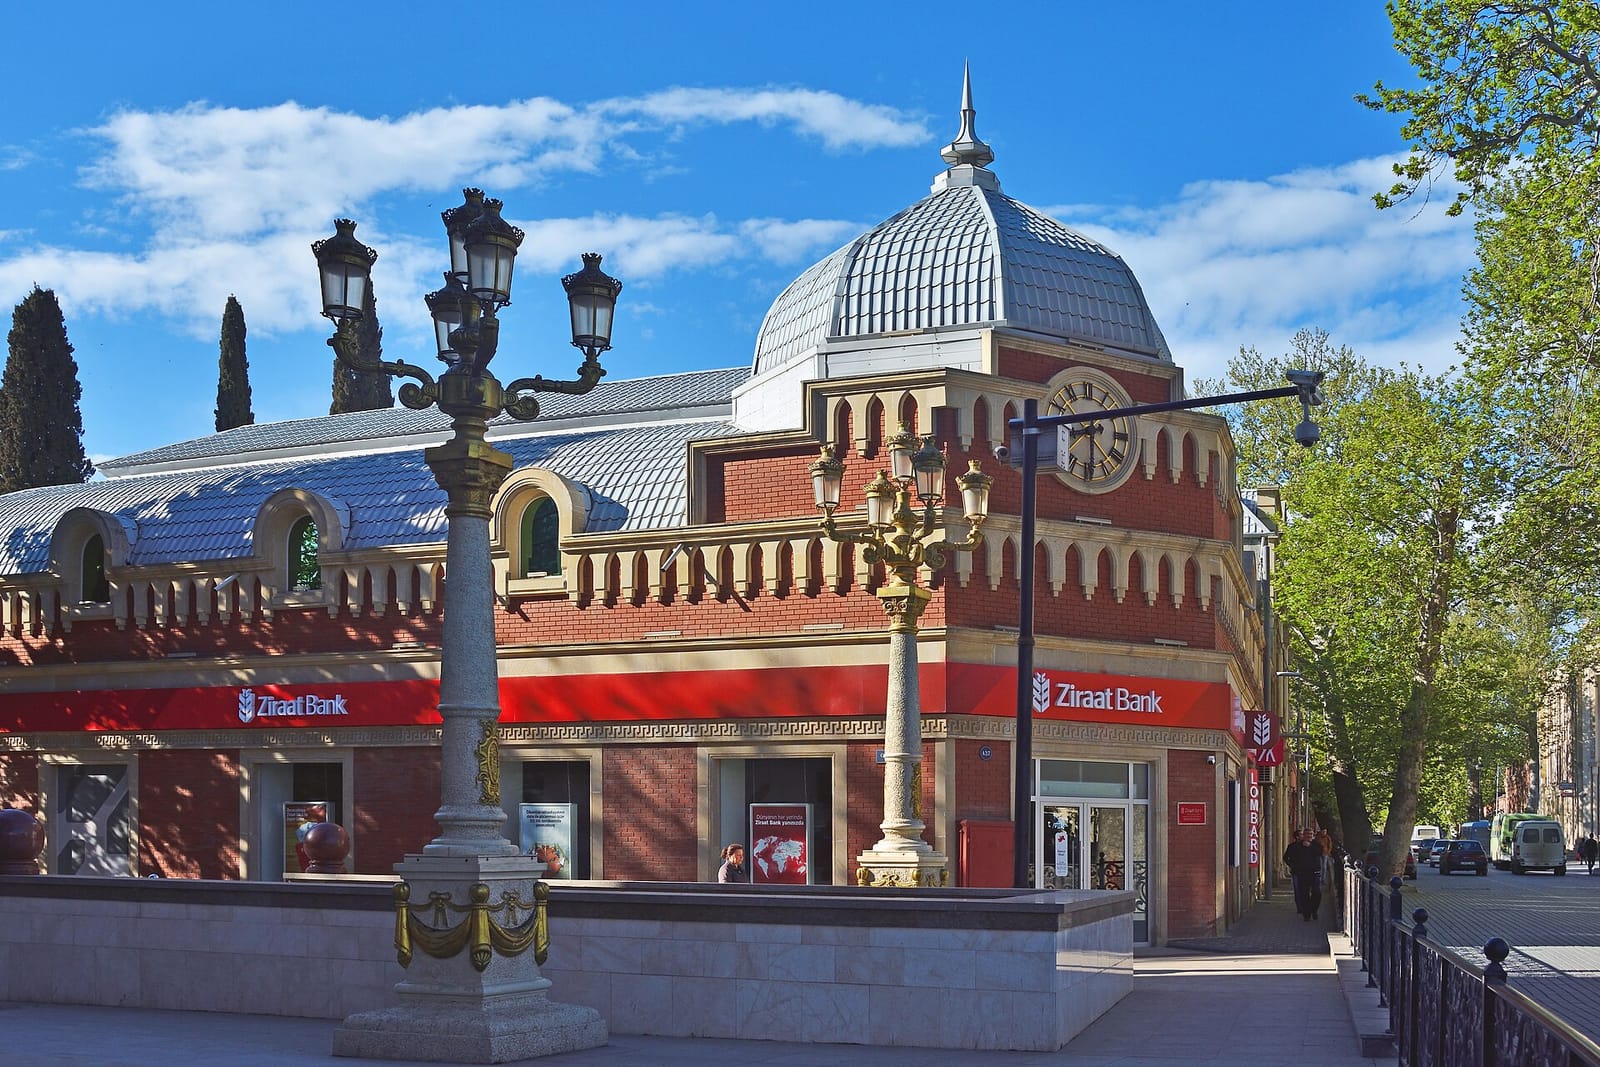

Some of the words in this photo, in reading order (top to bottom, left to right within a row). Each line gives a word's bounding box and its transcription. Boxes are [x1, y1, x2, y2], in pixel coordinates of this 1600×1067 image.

[256, 696, 304, 716] Ziraat
[306, 694, 348, 715] Bank
[1055, 683, 1113, 710] Ziraat
[1115, 688, 1163, 713] Bank
[1250, 772, 1259, 863] LOMBARD
